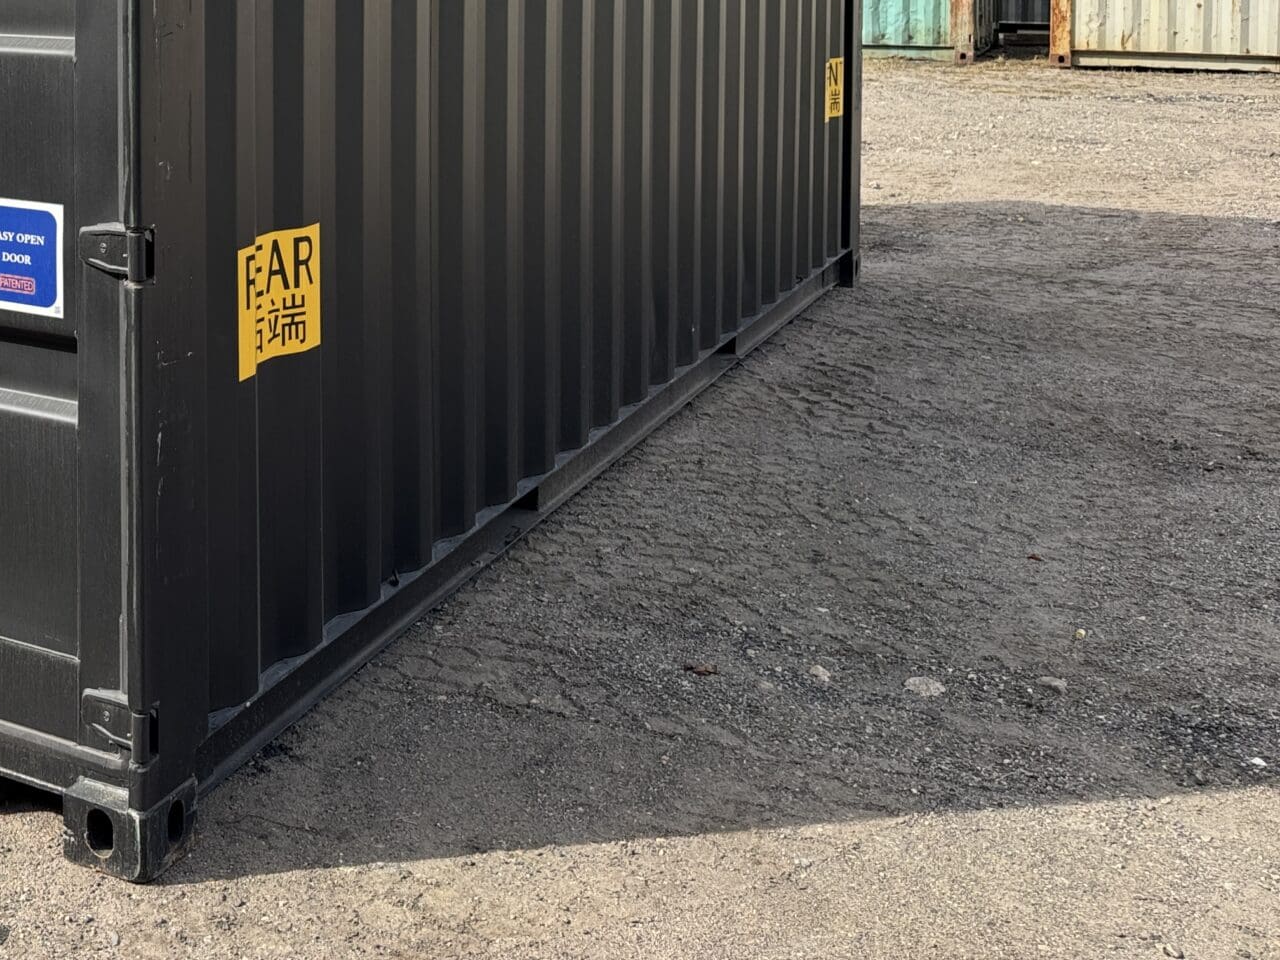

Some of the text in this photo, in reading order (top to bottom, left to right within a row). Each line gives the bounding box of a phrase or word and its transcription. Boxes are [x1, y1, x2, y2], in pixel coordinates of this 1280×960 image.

[16, 233, 45, 246] OPEN
[1, 251, 32, 265] DOOR
[0, 276, 33, 291] PATENTED
